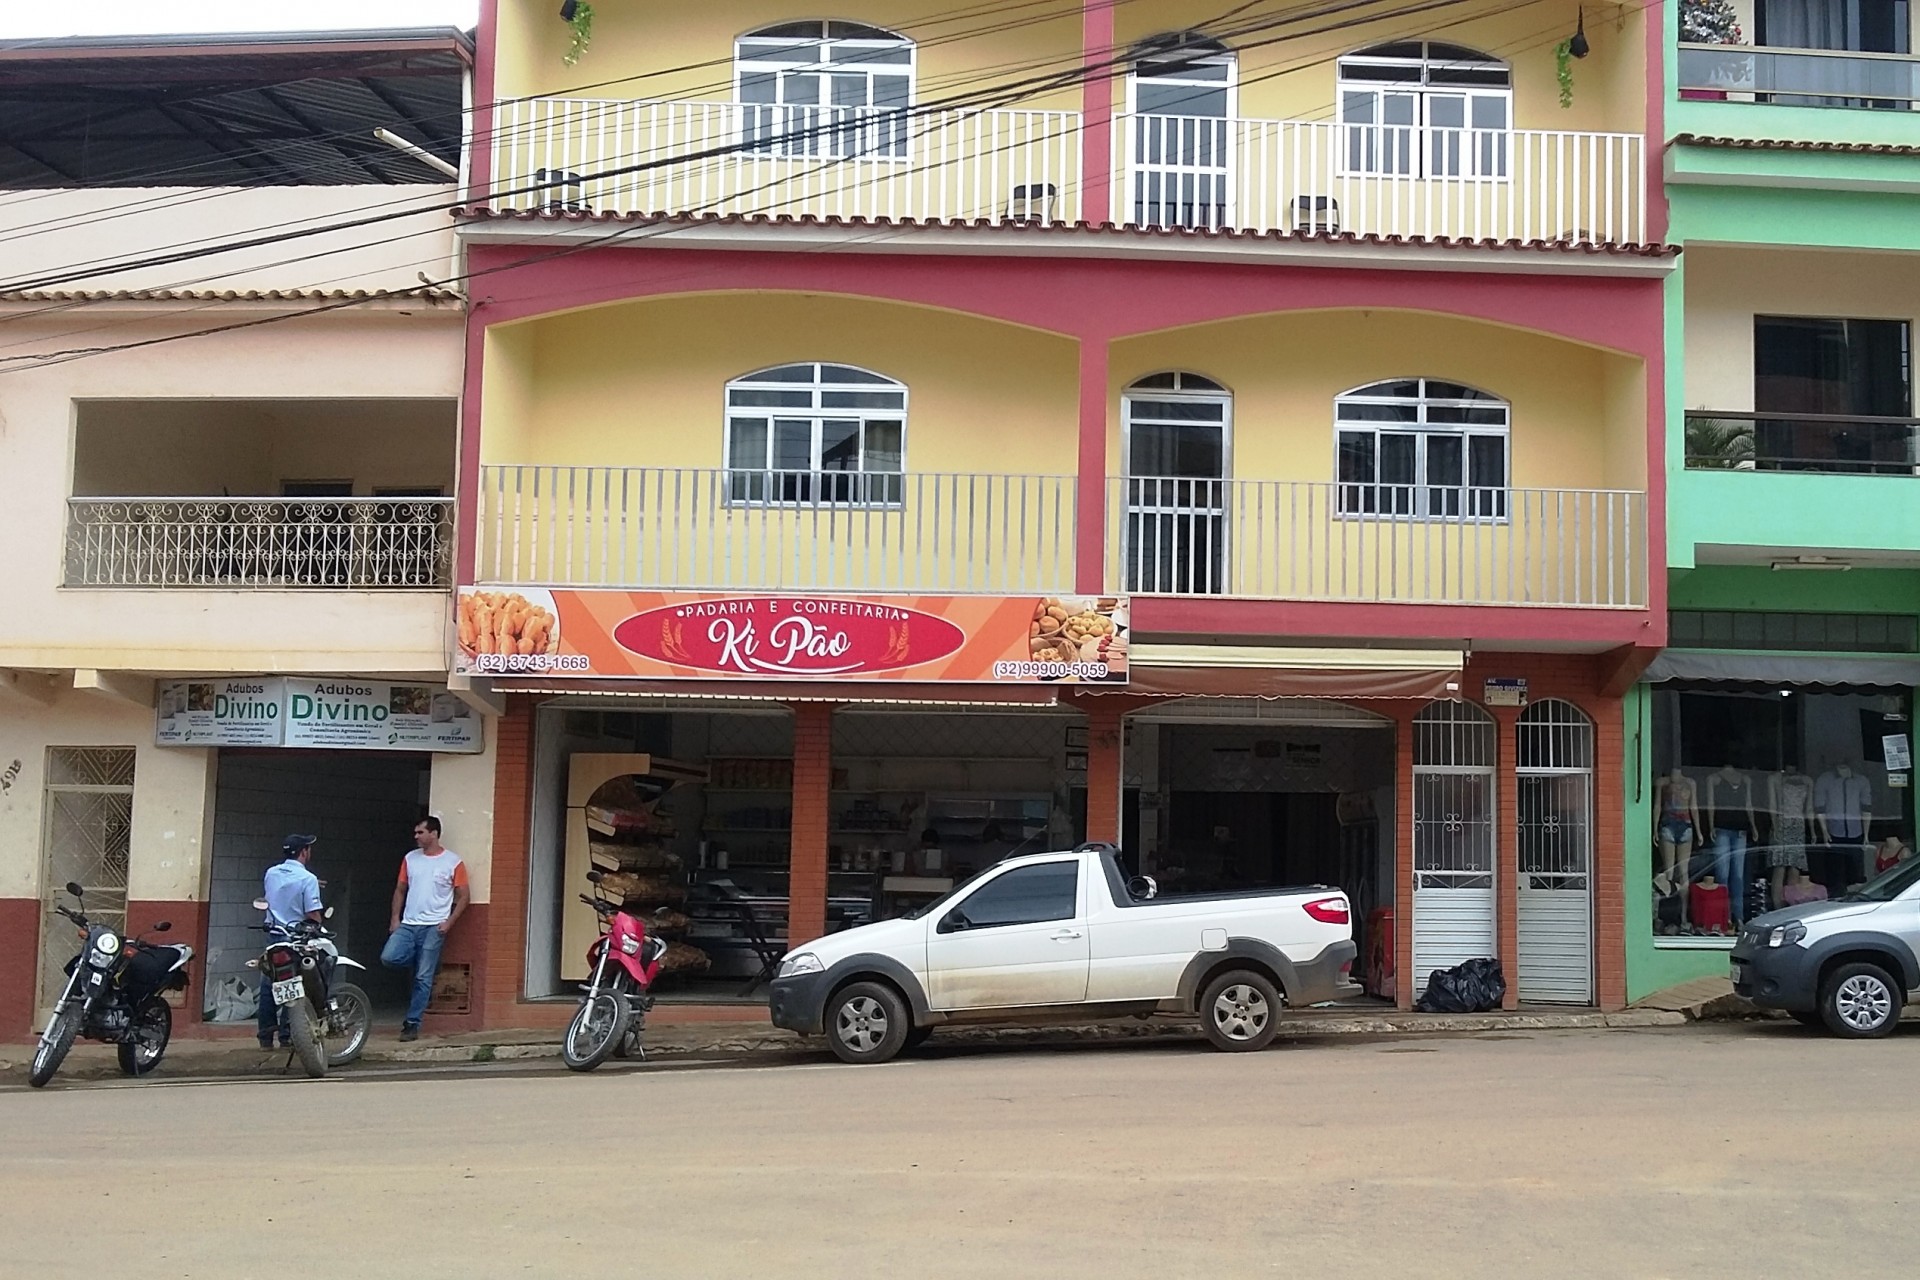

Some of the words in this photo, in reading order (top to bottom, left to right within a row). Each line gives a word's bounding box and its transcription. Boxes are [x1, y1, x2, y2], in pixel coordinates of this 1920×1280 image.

[686, 601, 755, 618] PADARIA
[770, 601, 777, 613] E
[793, 601, 900, 620] CONFEITARIA
[707, 617, 760, 672] Ki
[769, 615, 852, 665] Pão
[477, 655, 506, 671] (32)
[510, 655, 589, 670] 3743-1668
[993, 662, 1109, 678] (32)99900-5059
[226, 682, 264, 694] Adubos
[314, 683, 373, 696] Adubos
[215, 694, 278, 719] Divino
[291, 694, 389, 721] Divino
